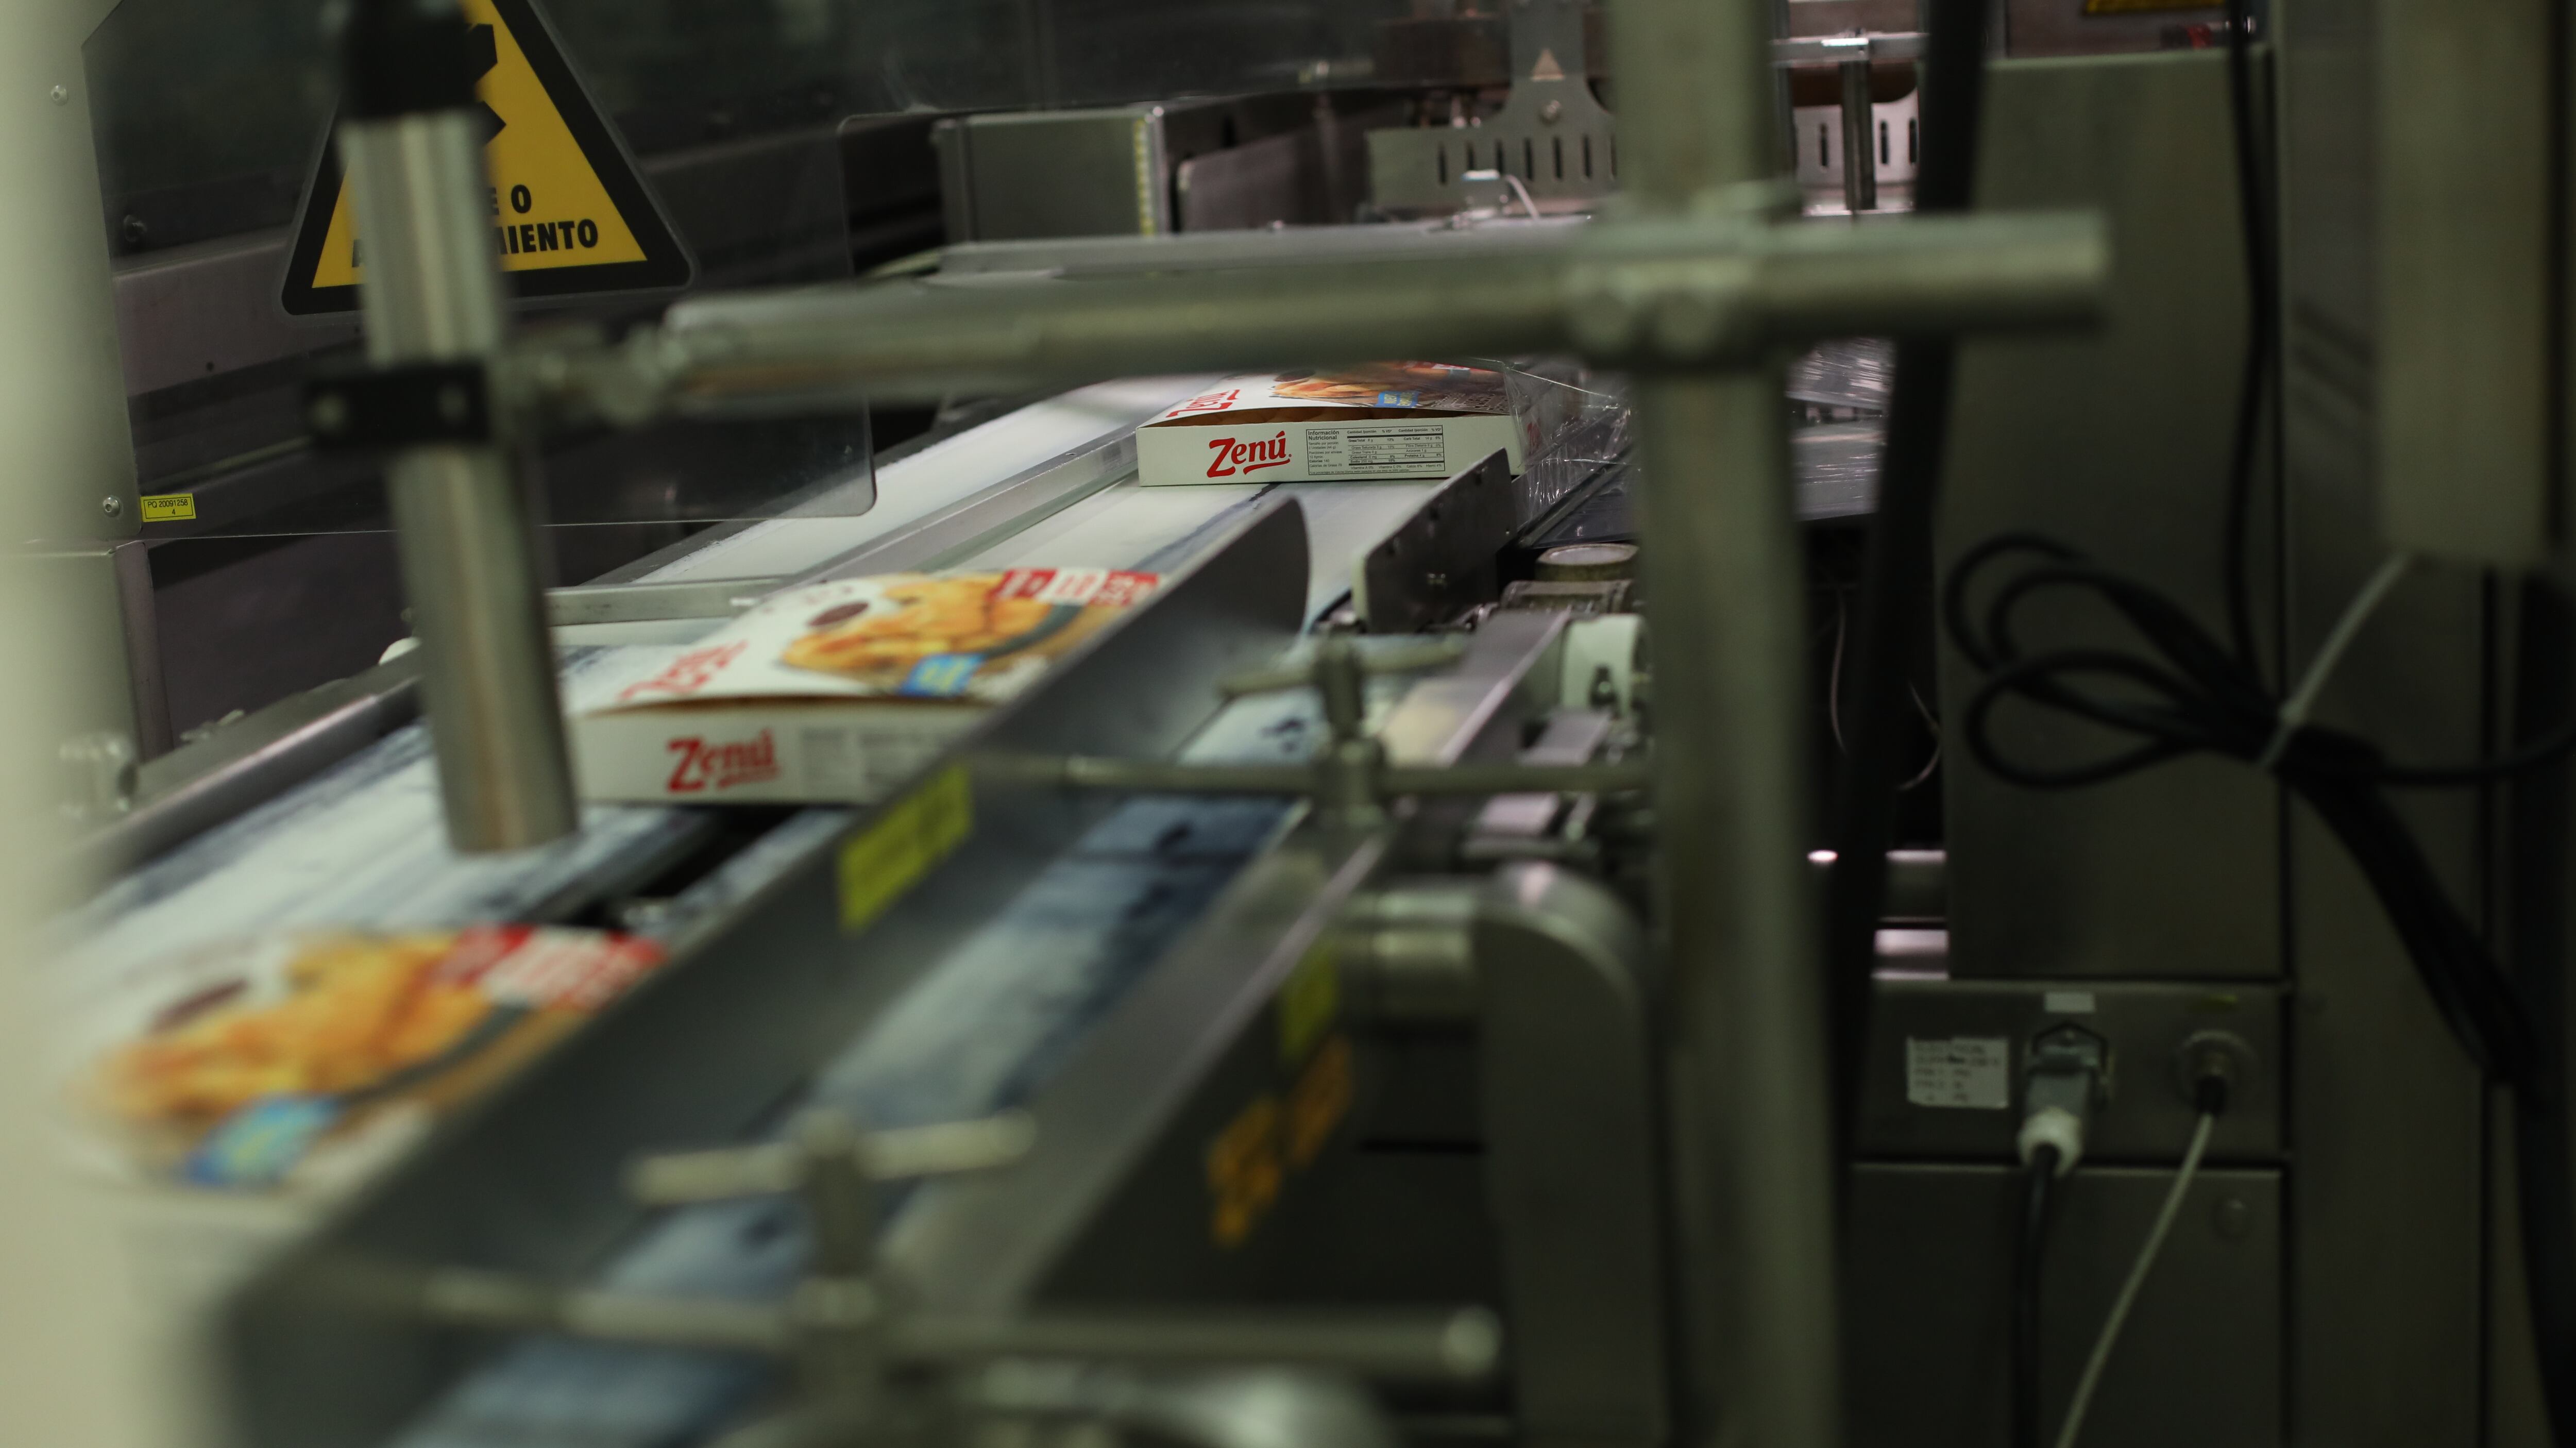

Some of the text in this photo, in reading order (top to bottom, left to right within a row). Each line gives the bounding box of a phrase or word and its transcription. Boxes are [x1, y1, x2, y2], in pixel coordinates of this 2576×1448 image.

[511, 184, 532, 214] O
[1207, 430, 1291, 478] Zenú
[159, 498, 189, 508] 20091258
